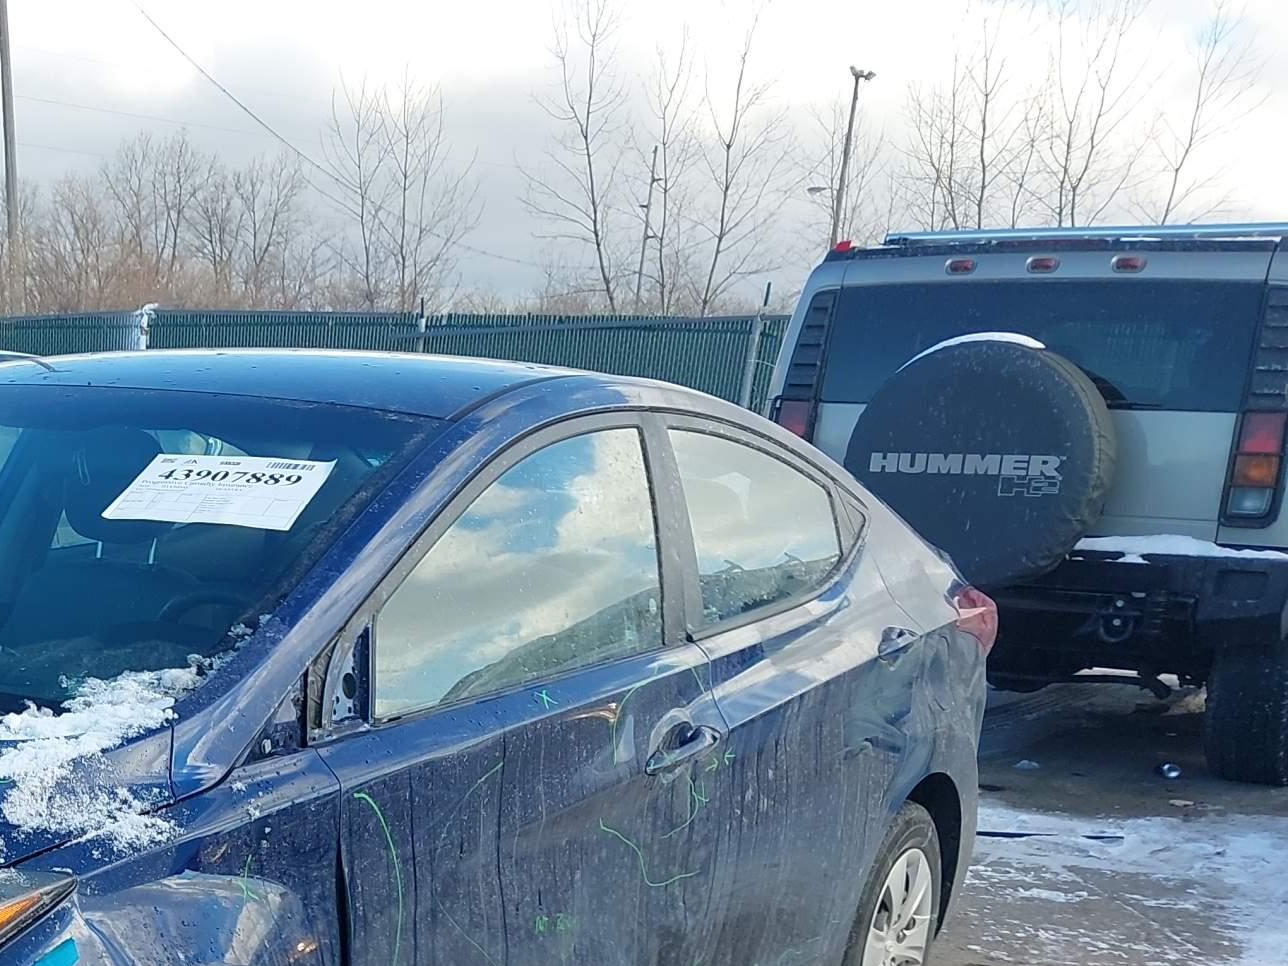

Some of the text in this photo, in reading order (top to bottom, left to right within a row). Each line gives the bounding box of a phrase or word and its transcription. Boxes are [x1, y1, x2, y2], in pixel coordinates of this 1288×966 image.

[869, 452, 1062, 477] HUMMER
[158, 468, 303, 487] 43907889
[997, 475, 1060, 497] H2
